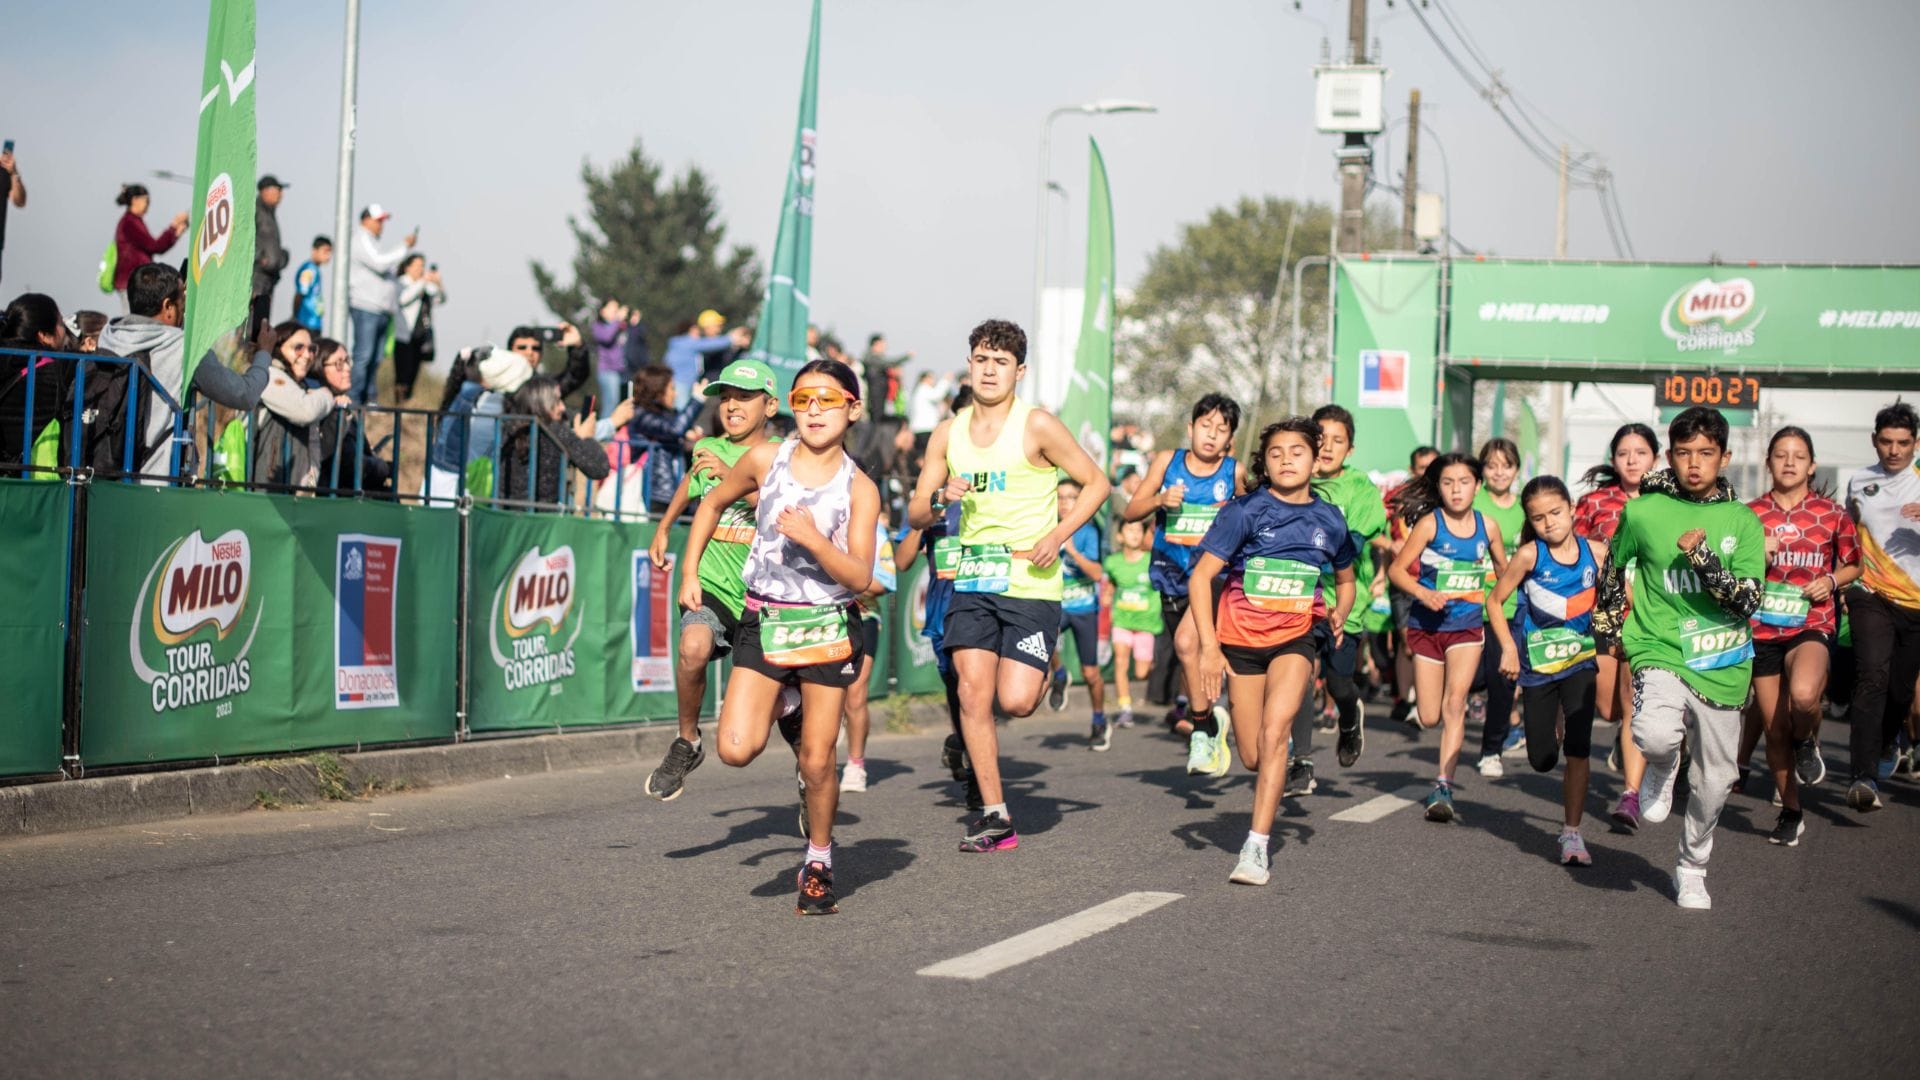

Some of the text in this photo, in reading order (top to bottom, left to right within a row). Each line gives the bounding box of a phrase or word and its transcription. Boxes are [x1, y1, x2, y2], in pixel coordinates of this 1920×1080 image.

[203, 199, 230, 252] ILO
[1478, 302, 1610, 324] #MELAPUEDO
[1690, 293, 1746, 311] MILO
[1676, 330, 1755, 352] CORRIDAS
[212, 542, 242, 561] Nestlé
[168, 561, 243, 615] MILO
[514, 571, 569, 614] MILO
[1255, 575, 1305, 596] 5152
[771, 622, 840, 646] 5443
[166, 642, 212, 674] TOUR
[512, 635, 546, 659] TOUR
[1544, 641, 1581, 660] 620
[338, 669, 395, 692] Donaciones
[504, 651, 575, 691] CORRIDAS
[152, 659, 251, 713] CORRIDAS
